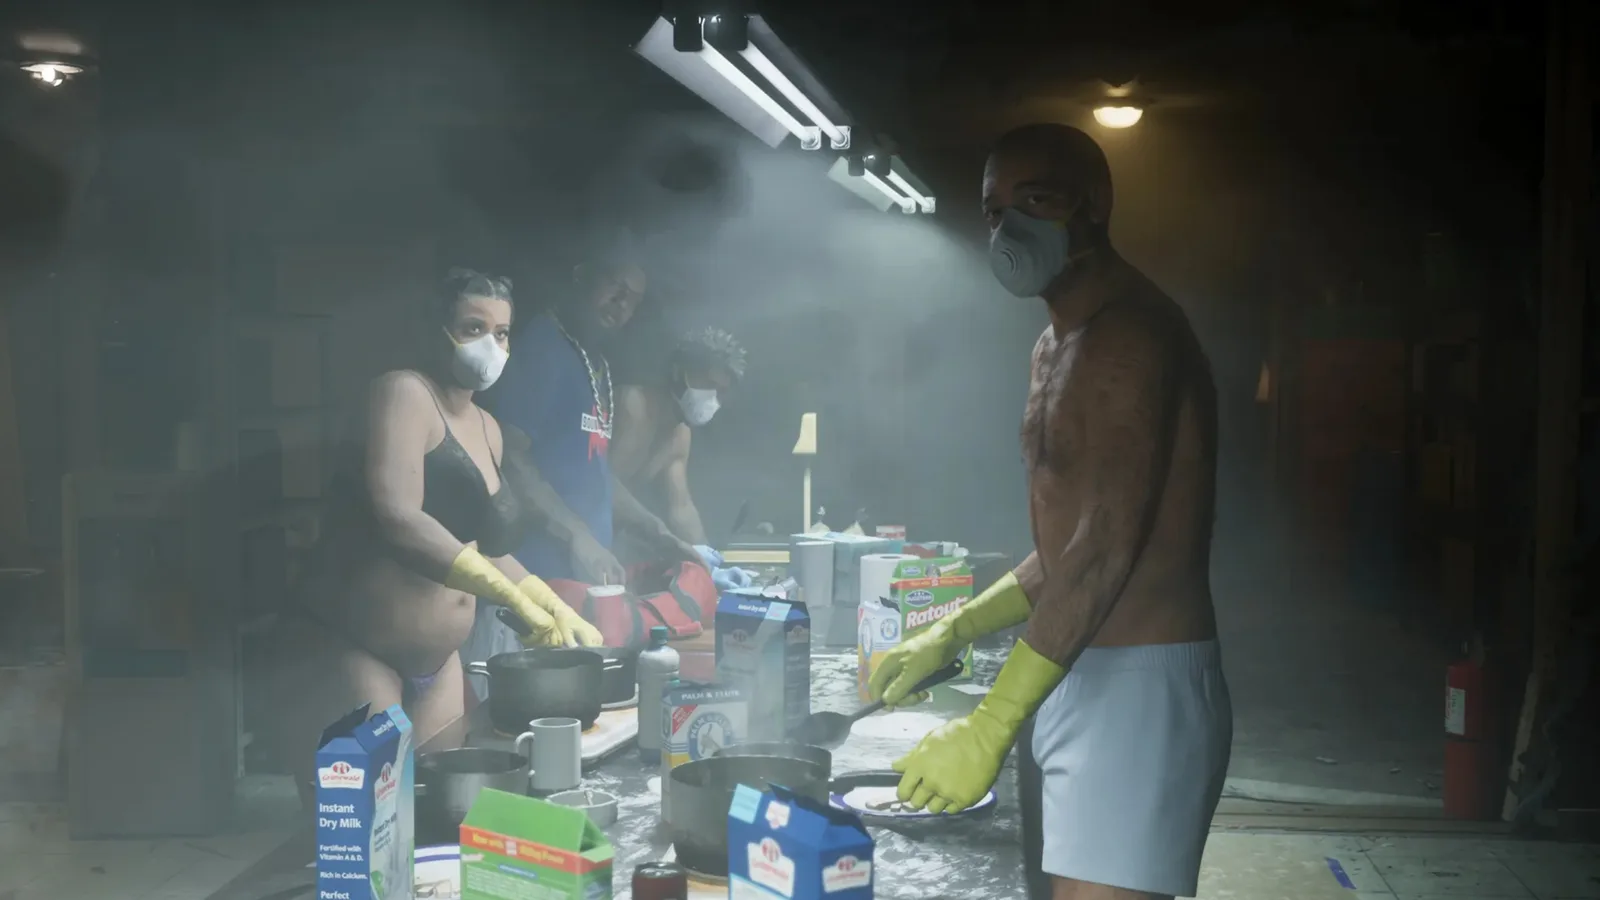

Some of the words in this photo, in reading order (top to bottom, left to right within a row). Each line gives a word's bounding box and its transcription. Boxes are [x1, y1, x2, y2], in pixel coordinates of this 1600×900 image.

[681, 692, 704, 701] PALM
[319, 803, 355, 813] Instant
[319, 817, 338, 830] Dry
[339, 818, 362, 828] Milk
[319, 844, 346, 852] Fortified
[320, 891, 350, 900] Perfect
